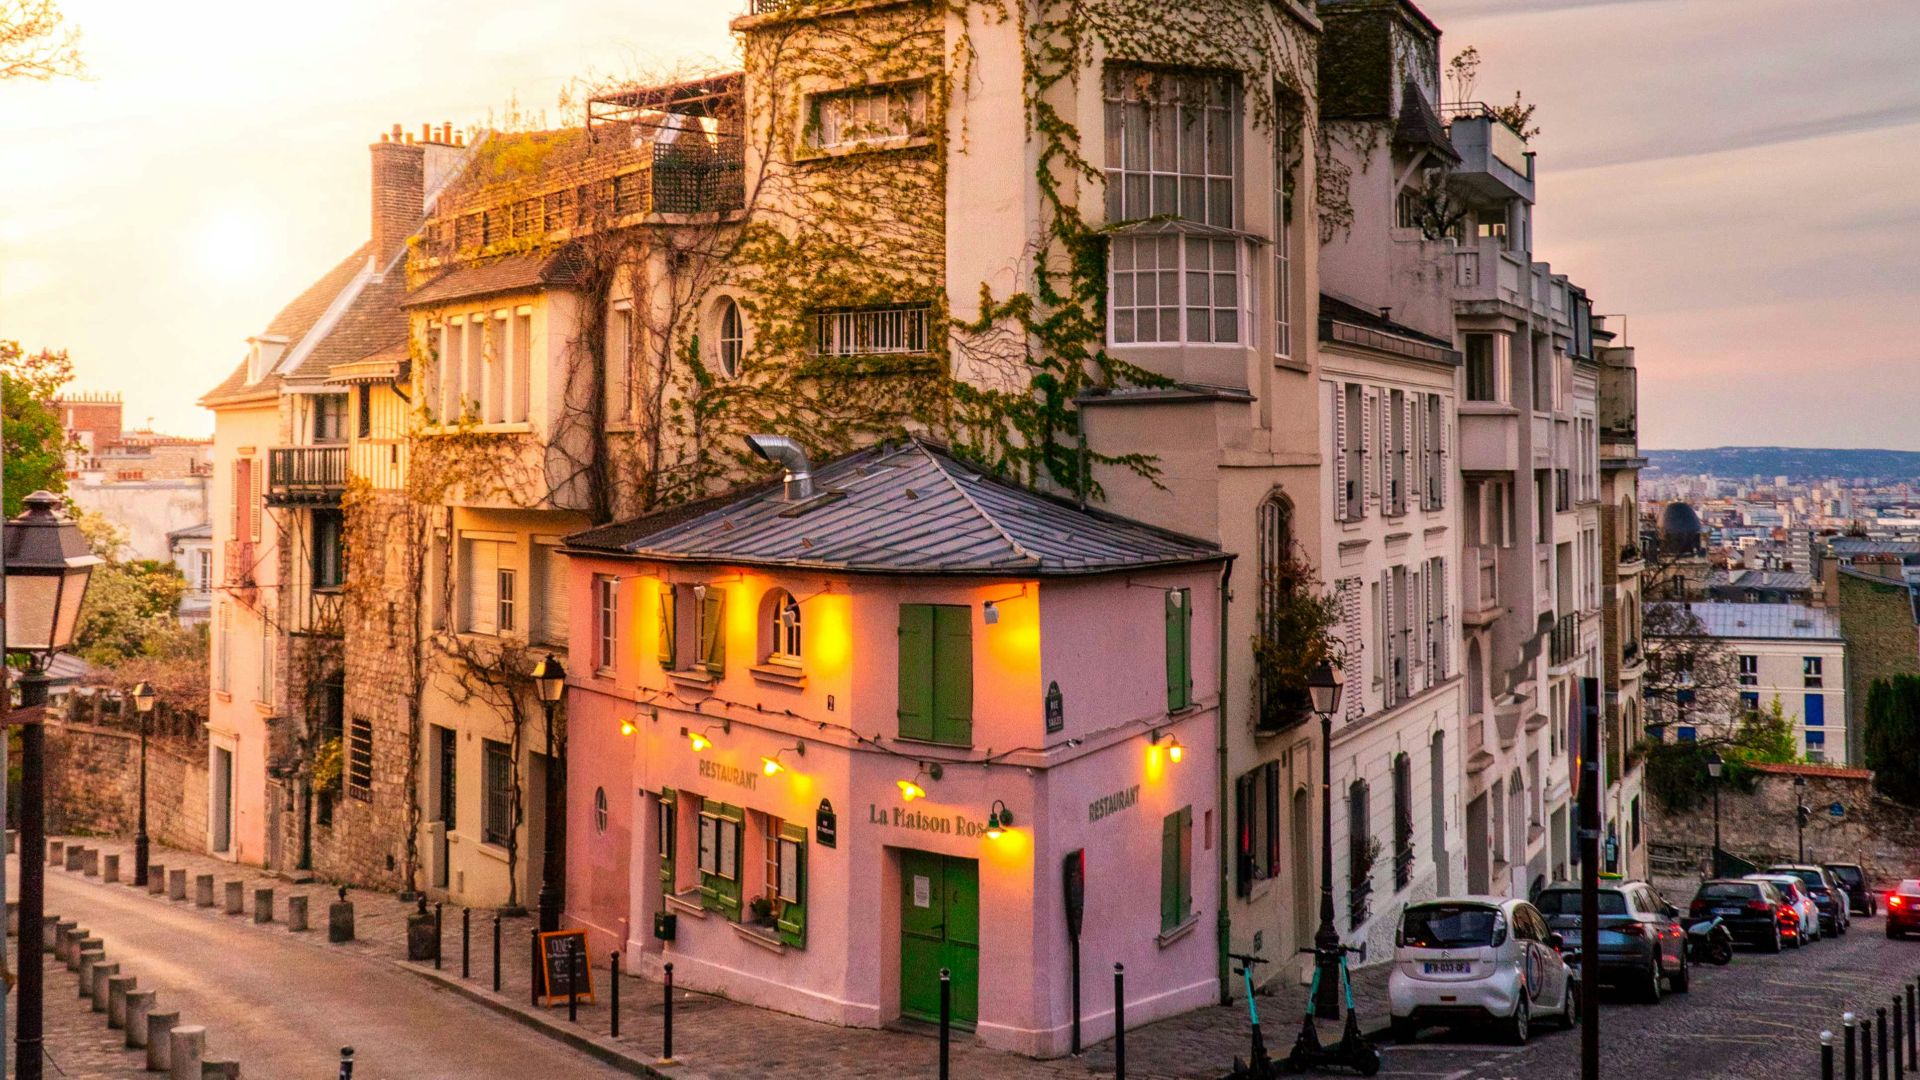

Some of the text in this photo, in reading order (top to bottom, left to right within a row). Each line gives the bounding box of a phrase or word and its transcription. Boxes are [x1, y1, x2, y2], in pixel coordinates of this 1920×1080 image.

[699, 759, 758, 792] RESTAURANT
[1089, 784, 1140, 822] RESTAURANT
[869, 804, 985, 839] La Maison Ros
